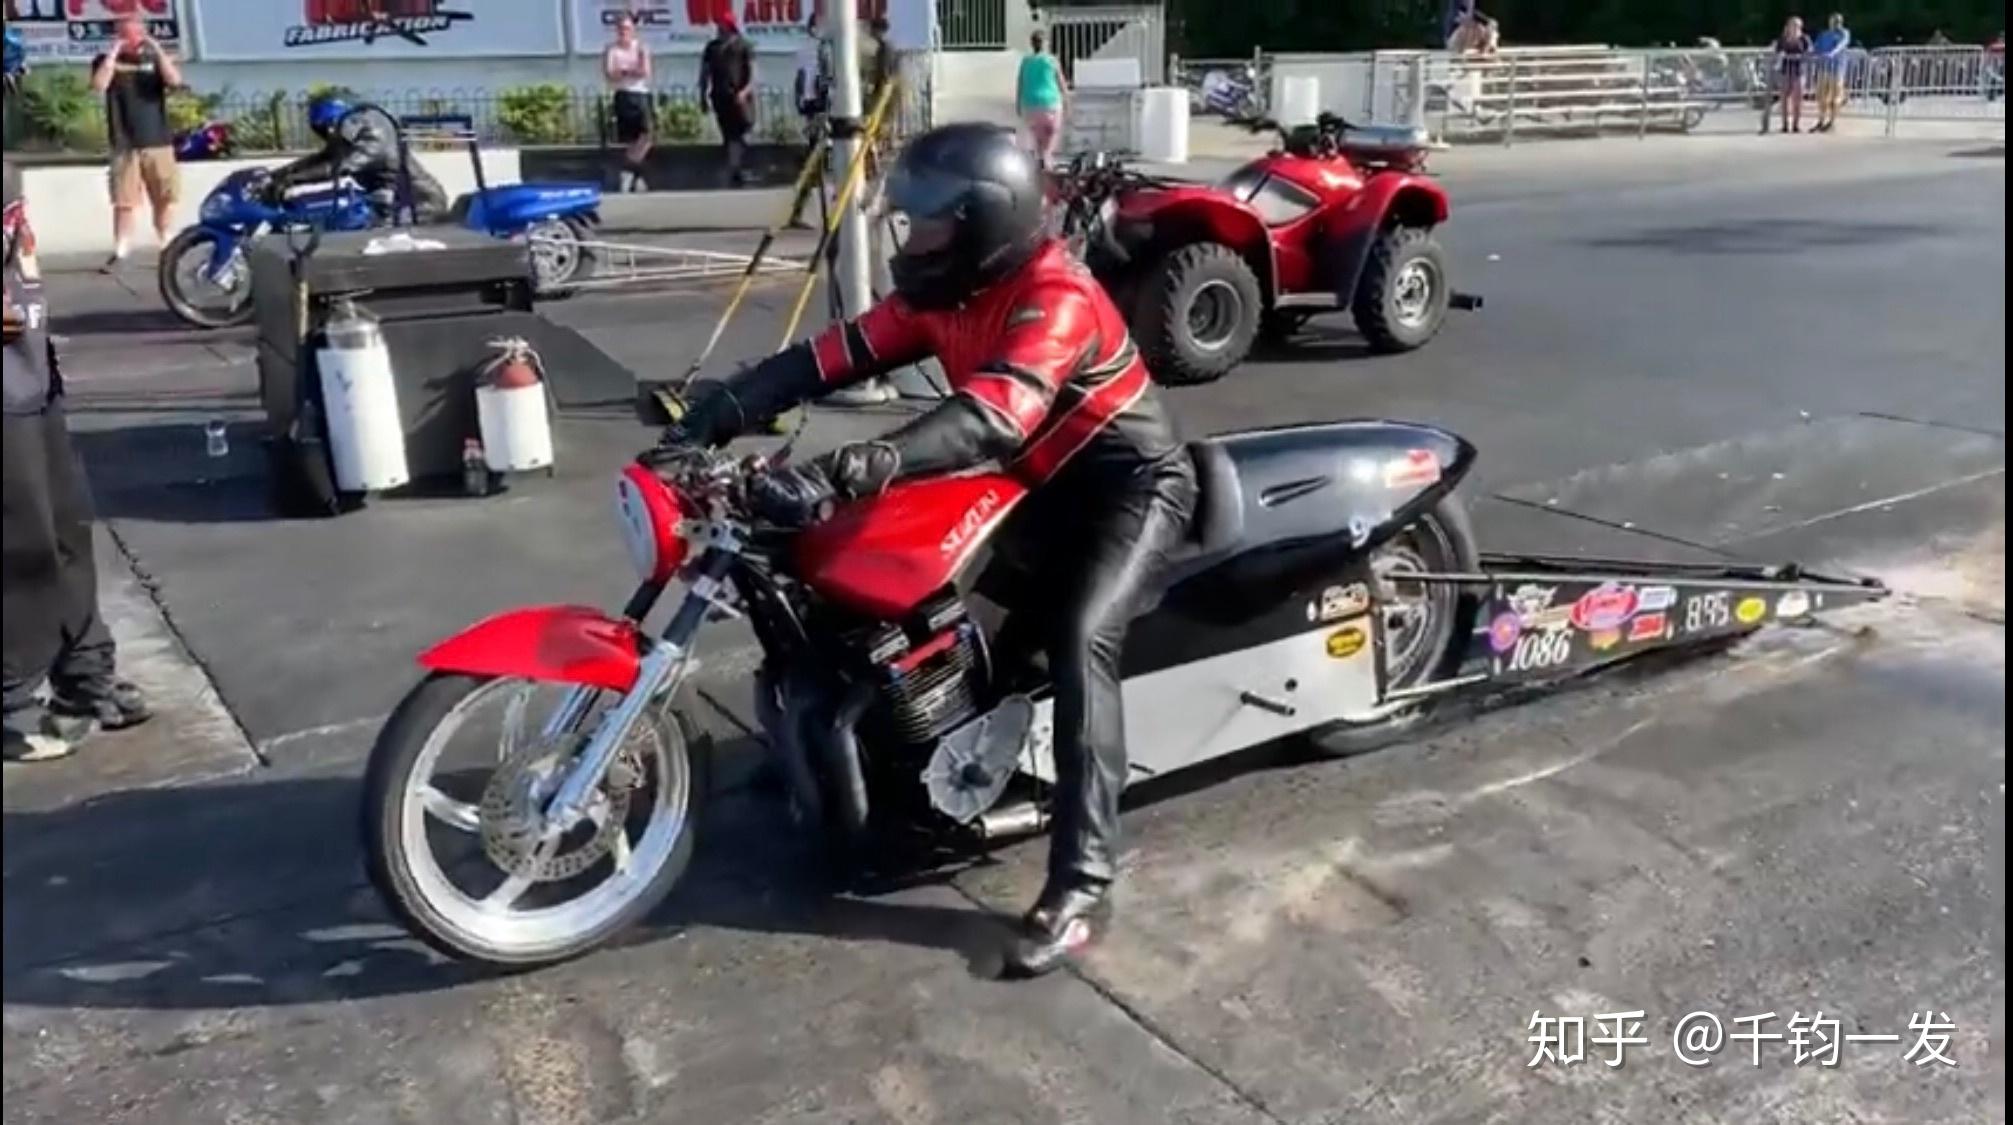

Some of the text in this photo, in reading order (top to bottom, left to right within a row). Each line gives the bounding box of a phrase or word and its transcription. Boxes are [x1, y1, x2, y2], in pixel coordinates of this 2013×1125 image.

[286, 17, 450, 46] FABRICATION
[601, 9, 672, 26] GMC
[939, 487, 1000, 561] SUZUKI
[1507, 629, 1575, 671] 1086
